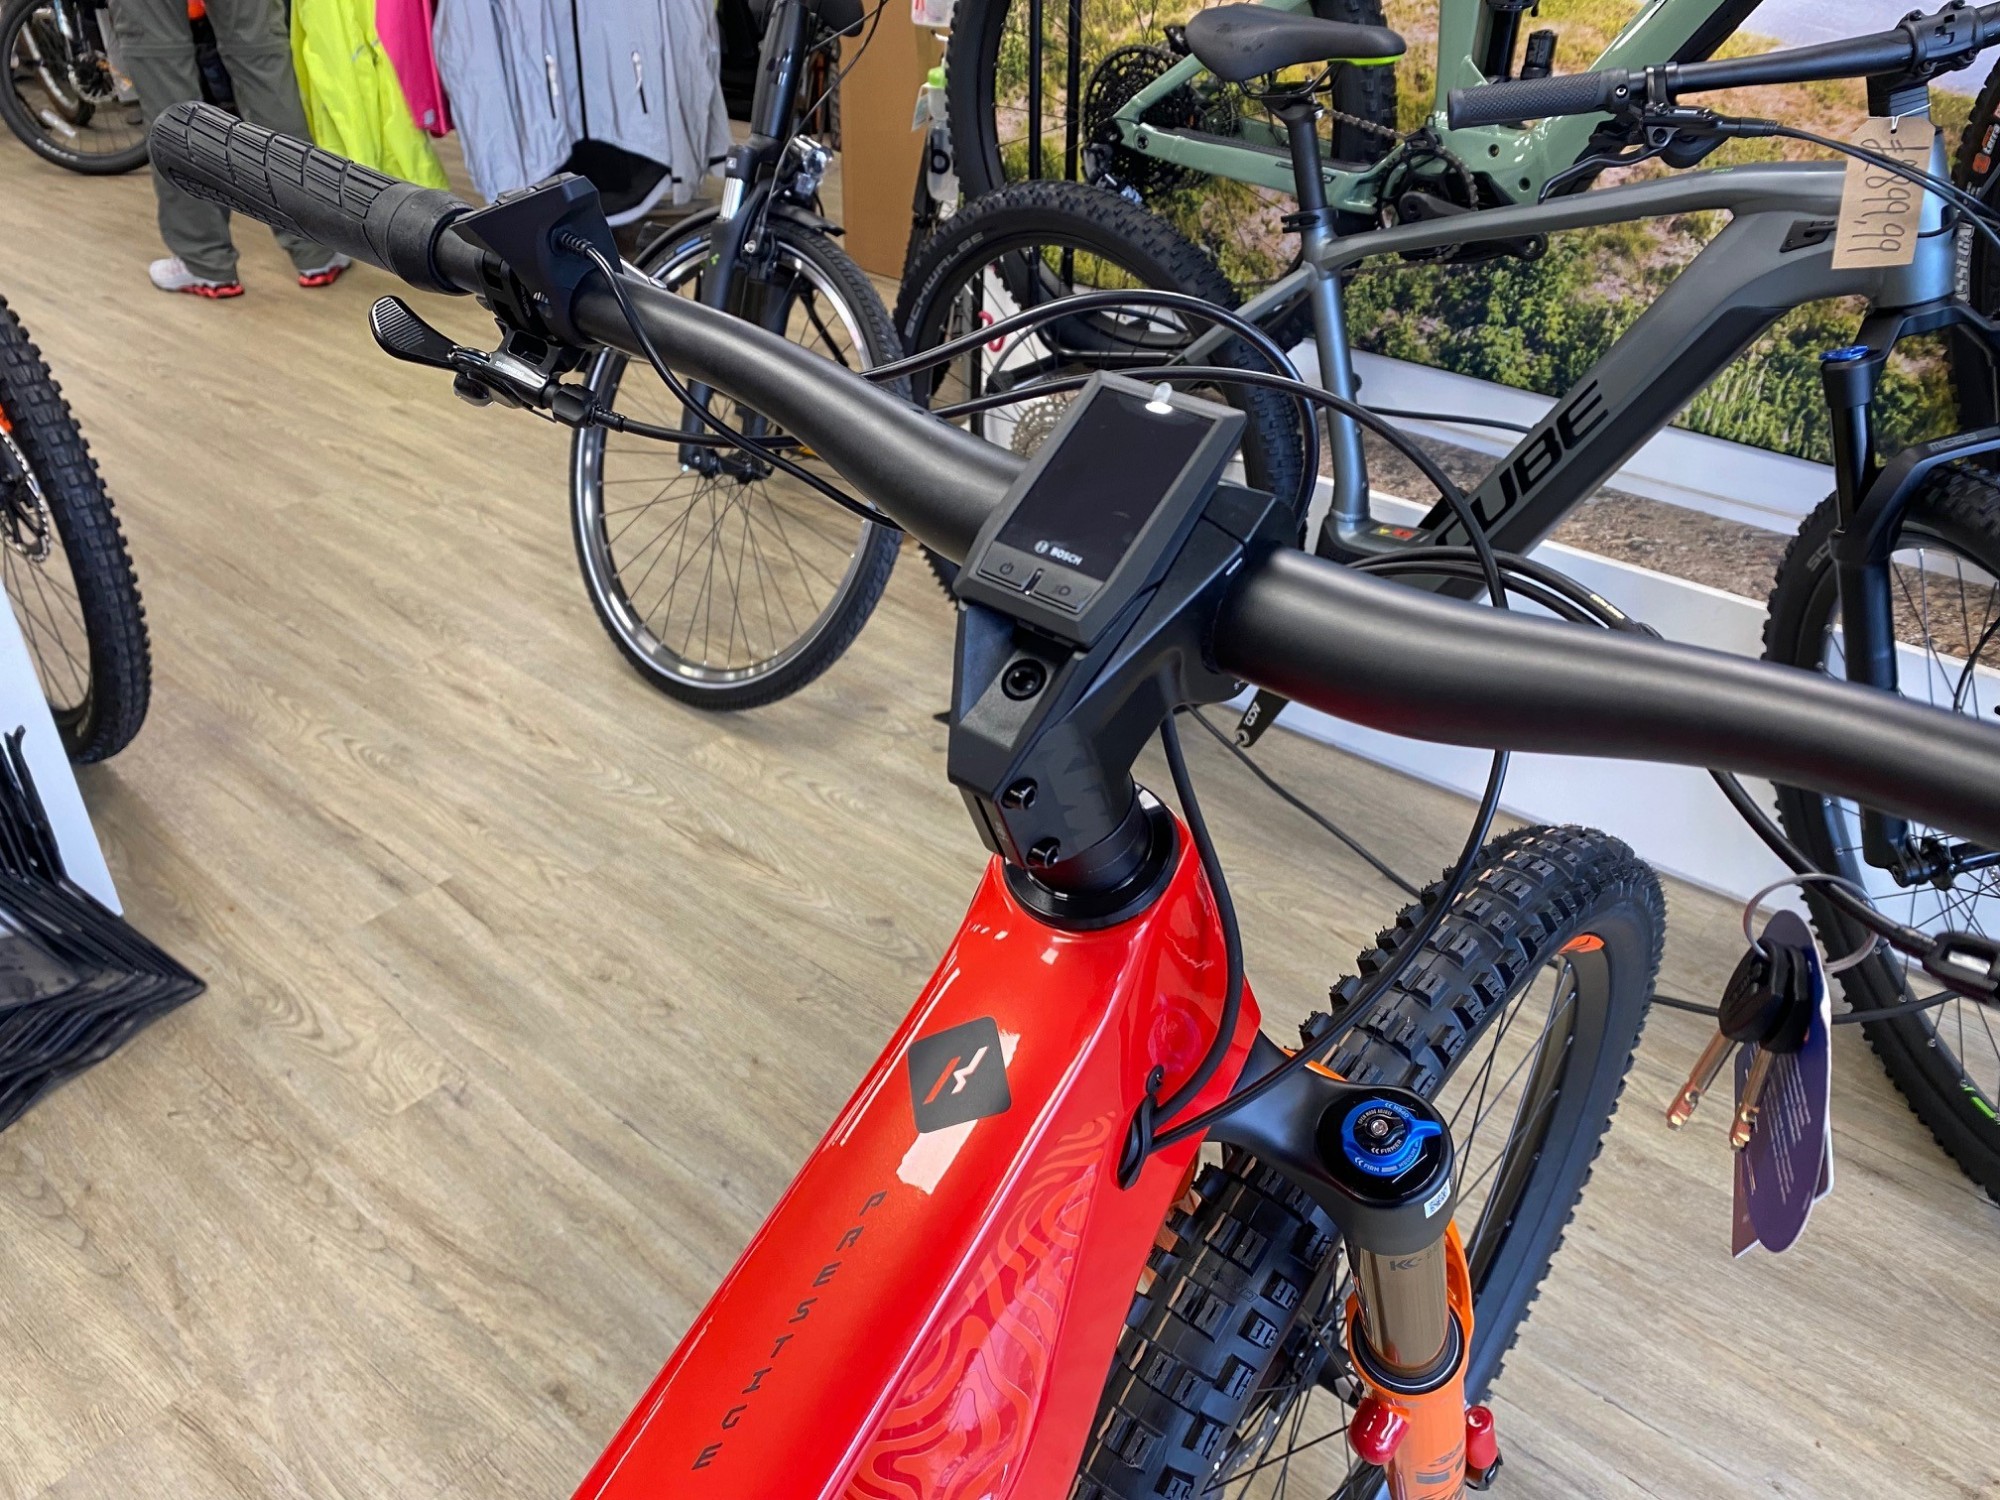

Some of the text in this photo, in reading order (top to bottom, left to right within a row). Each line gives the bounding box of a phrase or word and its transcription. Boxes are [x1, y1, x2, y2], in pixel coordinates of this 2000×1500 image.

[904, 231, 984, 338] SCHWALBE
[1050, 546, 1083, 566] BOSCH
[1380, 1139, 1402, 1155] FIRMER
[1363, 1163, 1380, 1173] FIRM
[691, 1190, 888, 1471] PRESTIGE
